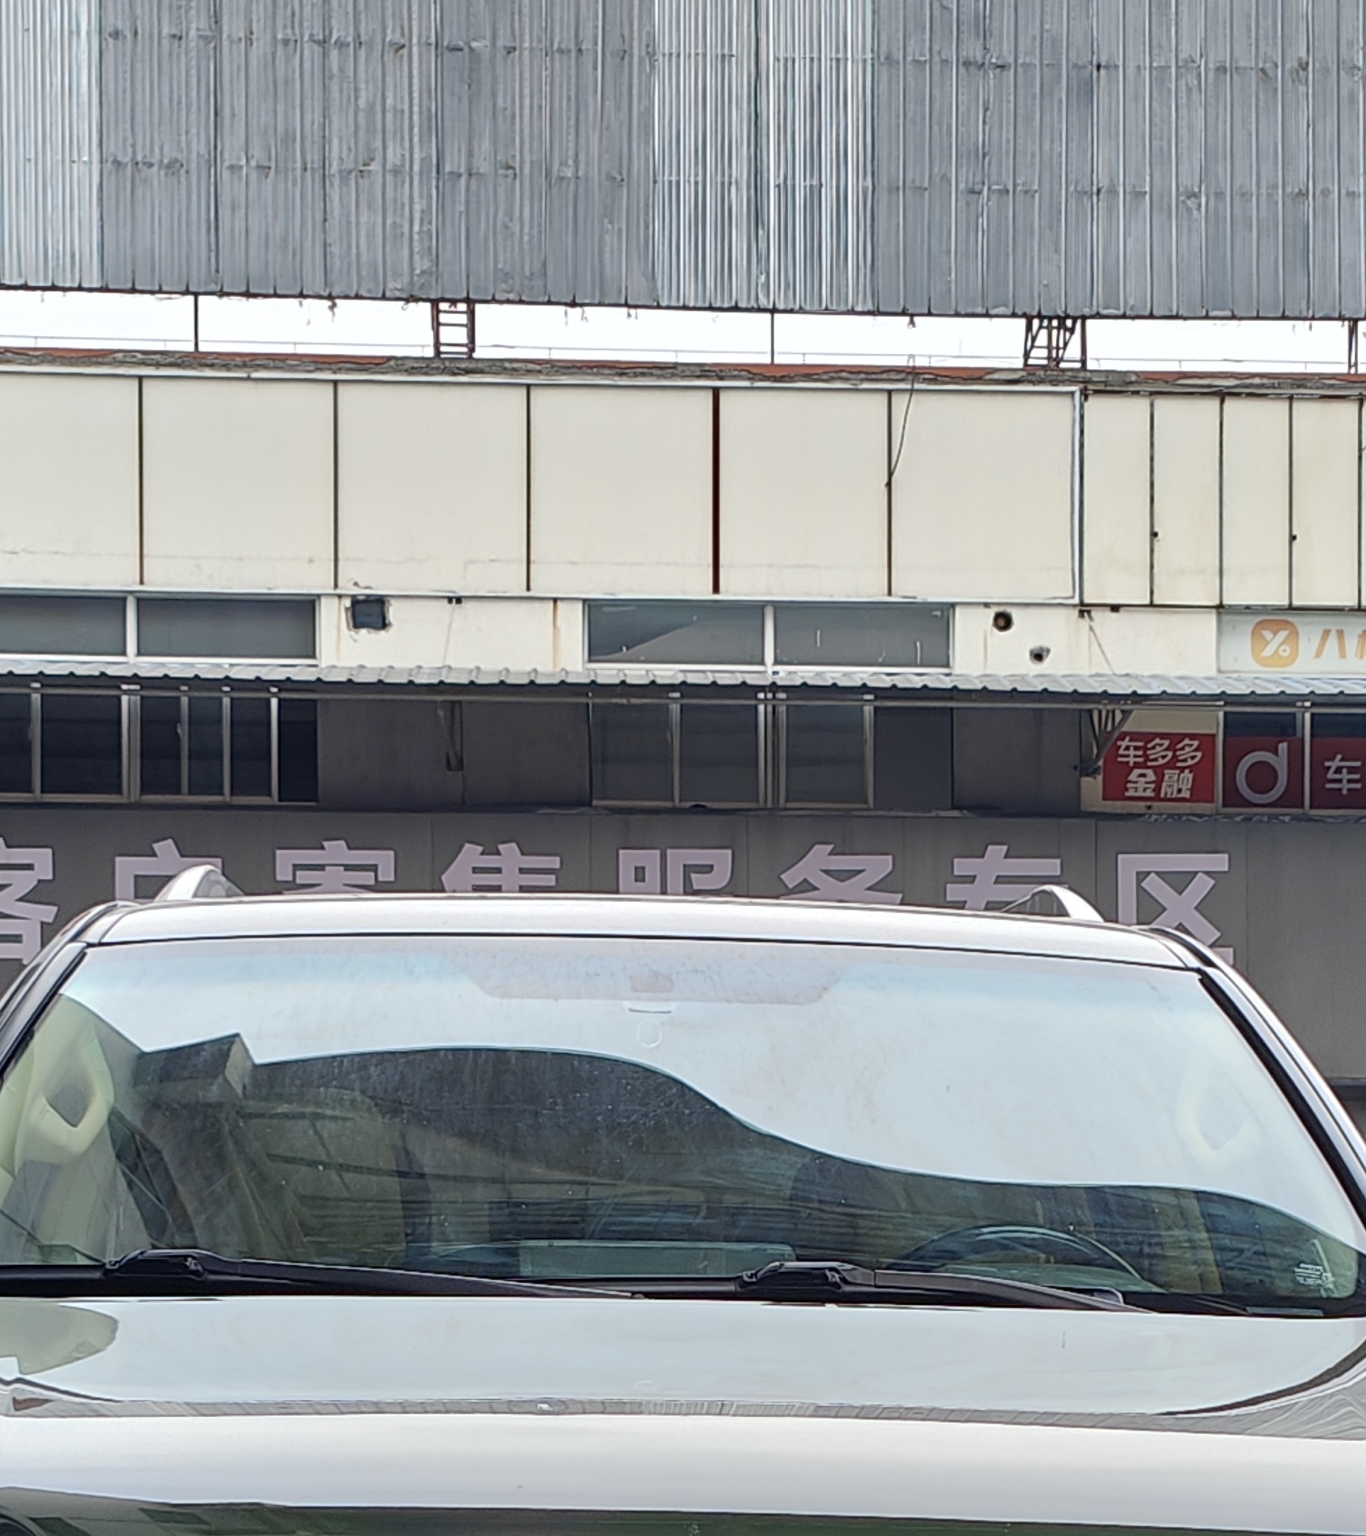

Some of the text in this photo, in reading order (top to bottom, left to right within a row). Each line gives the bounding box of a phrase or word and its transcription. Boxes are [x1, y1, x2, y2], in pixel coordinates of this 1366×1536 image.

[1116, 736, 1203, 767] 车多多
[1124, 768, 1191, 799] 金融
